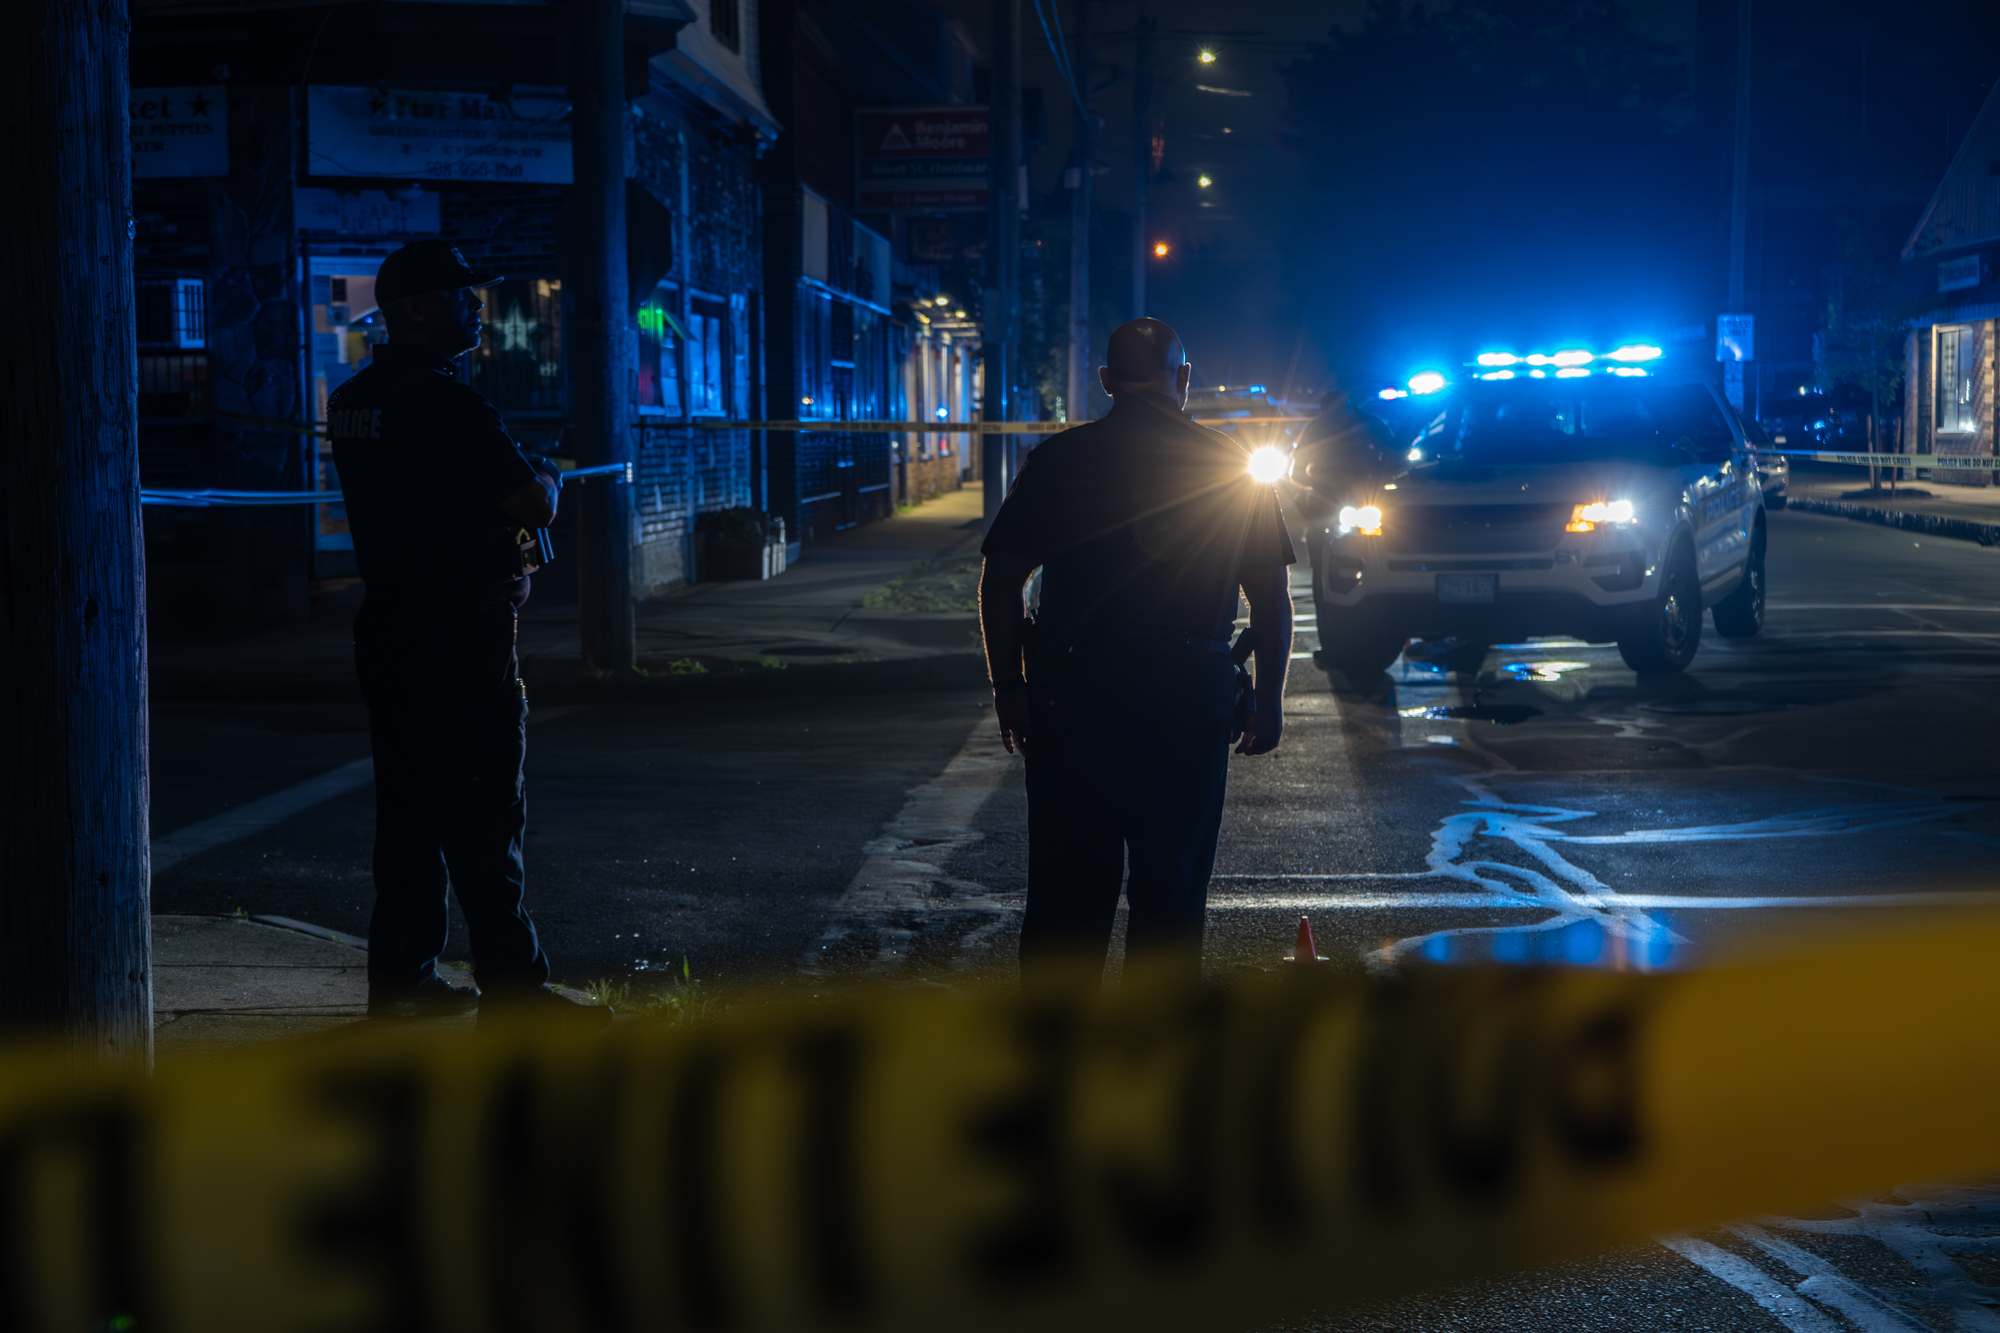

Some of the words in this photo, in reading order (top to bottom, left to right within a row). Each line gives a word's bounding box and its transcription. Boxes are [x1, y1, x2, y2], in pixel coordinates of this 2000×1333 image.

[914, 119, 988, 139] Benjamin
[914, 136, 966, 149] Moore
[327, 408, 383, 439] POLICE
[1880, 456, 1891, 465] NOT
[1937, 457, 1957, 467] POLICE
[1972, 458, 1981, 467] DO
[1982, 458, 1993, 468] NOT
[1706, 487, 1740, 522] POLICE
